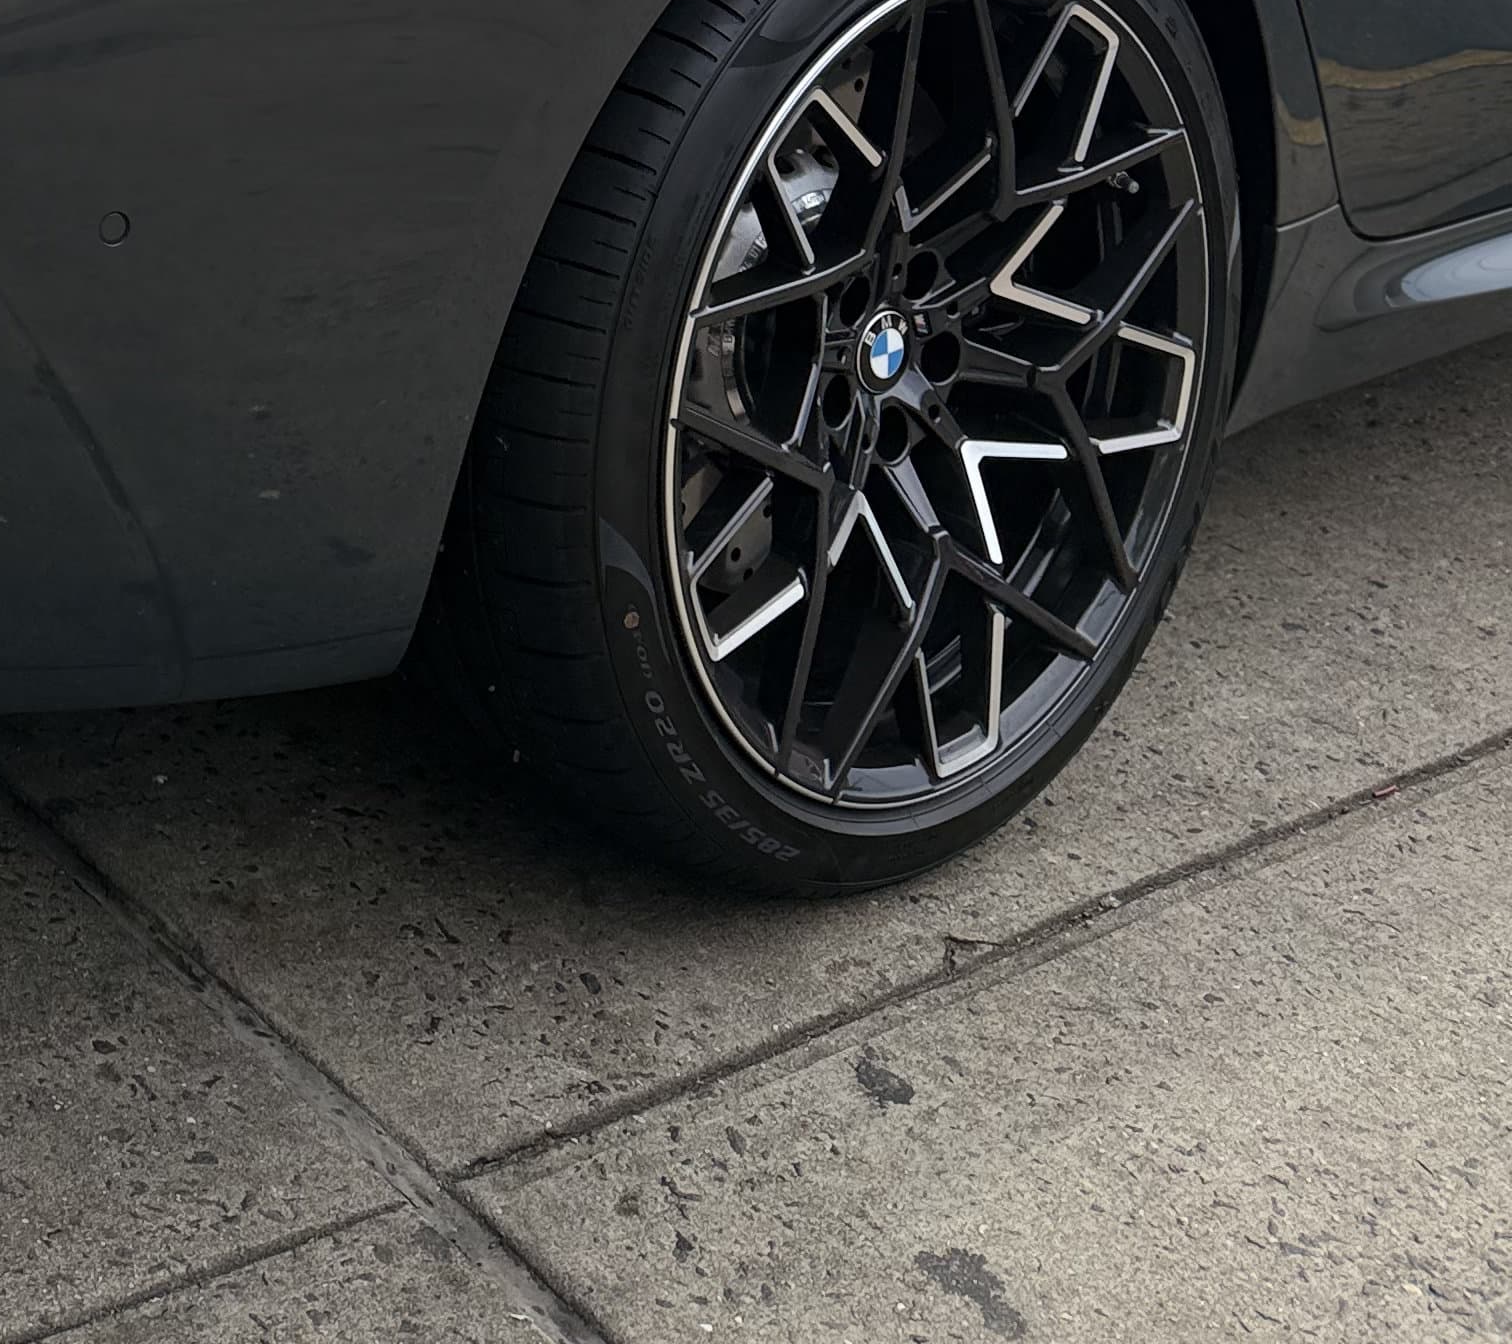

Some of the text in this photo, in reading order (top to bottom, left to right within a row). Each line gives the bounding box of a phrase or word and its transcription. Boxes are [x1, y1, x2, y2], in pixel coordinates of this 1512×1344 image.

[864, 314, 909, 347] BMW
[643, 690, 707, 785] ZR20
[697, 788, 801, 863] 285/35
